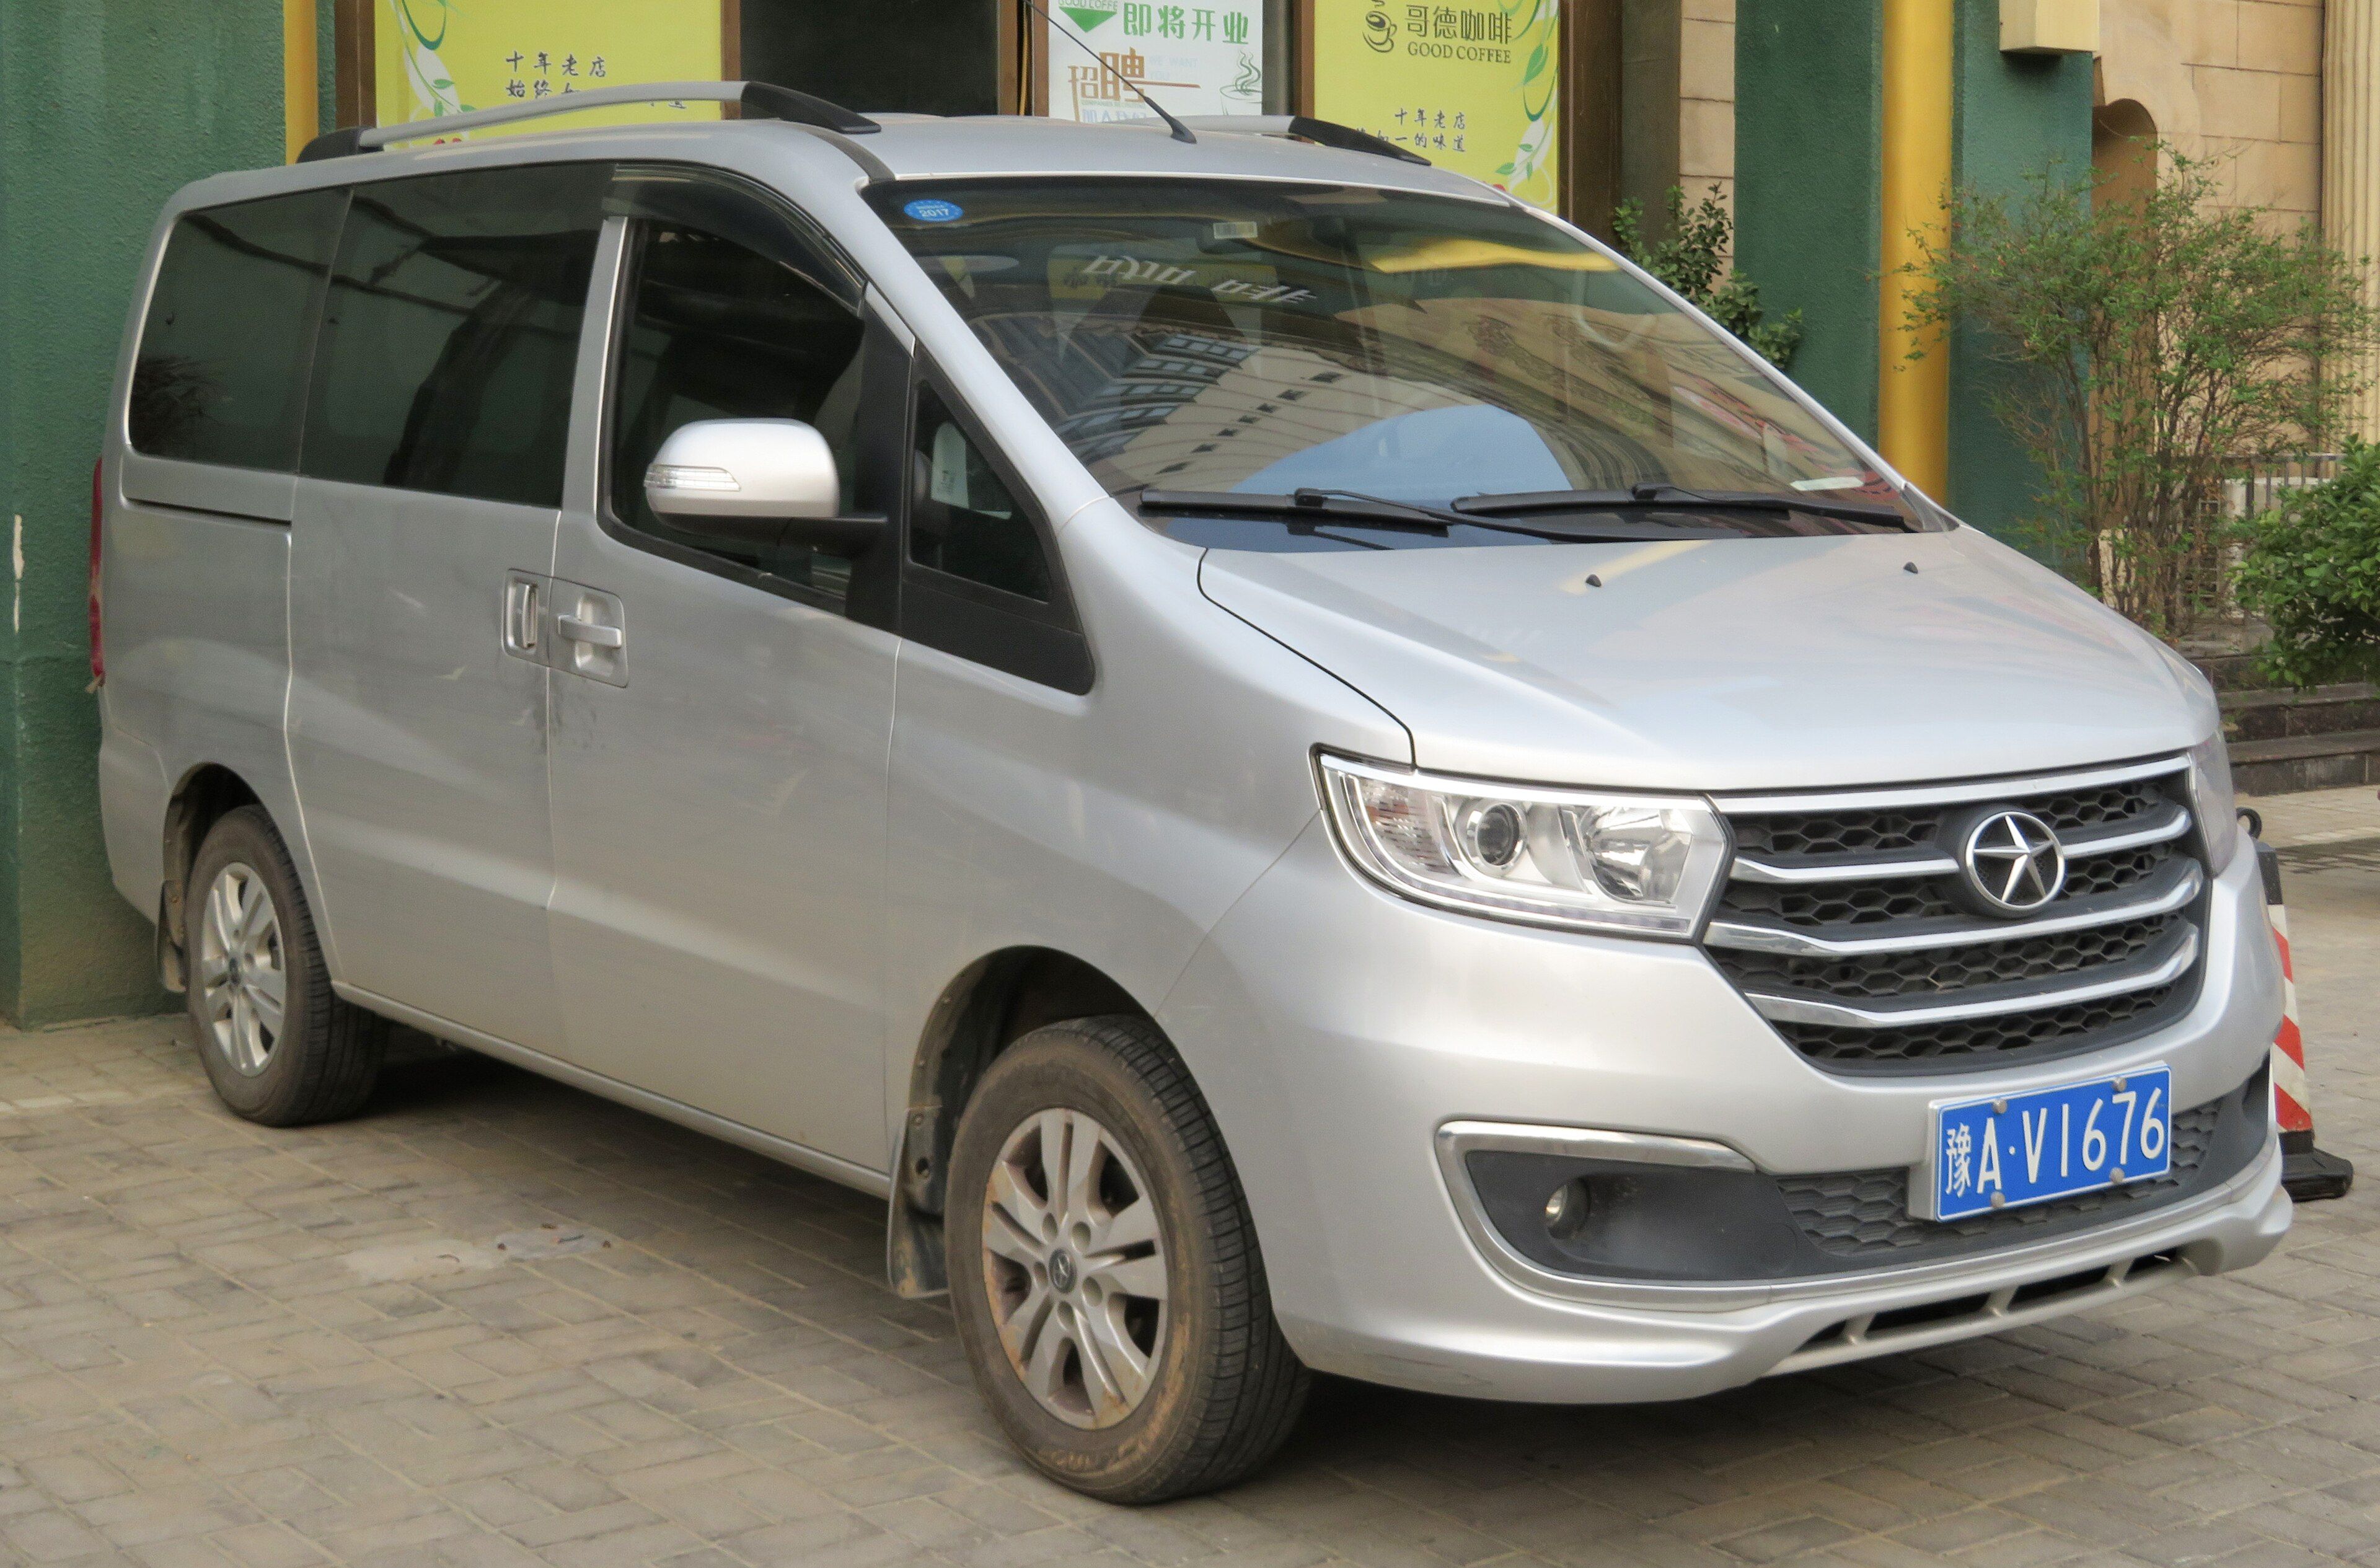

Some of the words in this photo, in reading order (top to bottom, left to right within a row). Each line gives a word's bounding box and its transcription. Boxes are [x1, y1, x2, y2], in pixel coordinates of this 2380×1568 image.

[1123, 2, 1249, 45] 即将开业
[1404, 5, 1512, 45] 哥德咖啡
[506, 50, 606, 77] 十年老店
[1408, 42, 1453, 59] GOOD
[1457, 45, 1512, 64] COFFEE
[1067, 46, 1201, 122] 招聘
[1395, 108, 1465, 130] 十年老店
[1355, 127, 1466, 152] 一的味道
[919, 208, 950, 218] 2017
